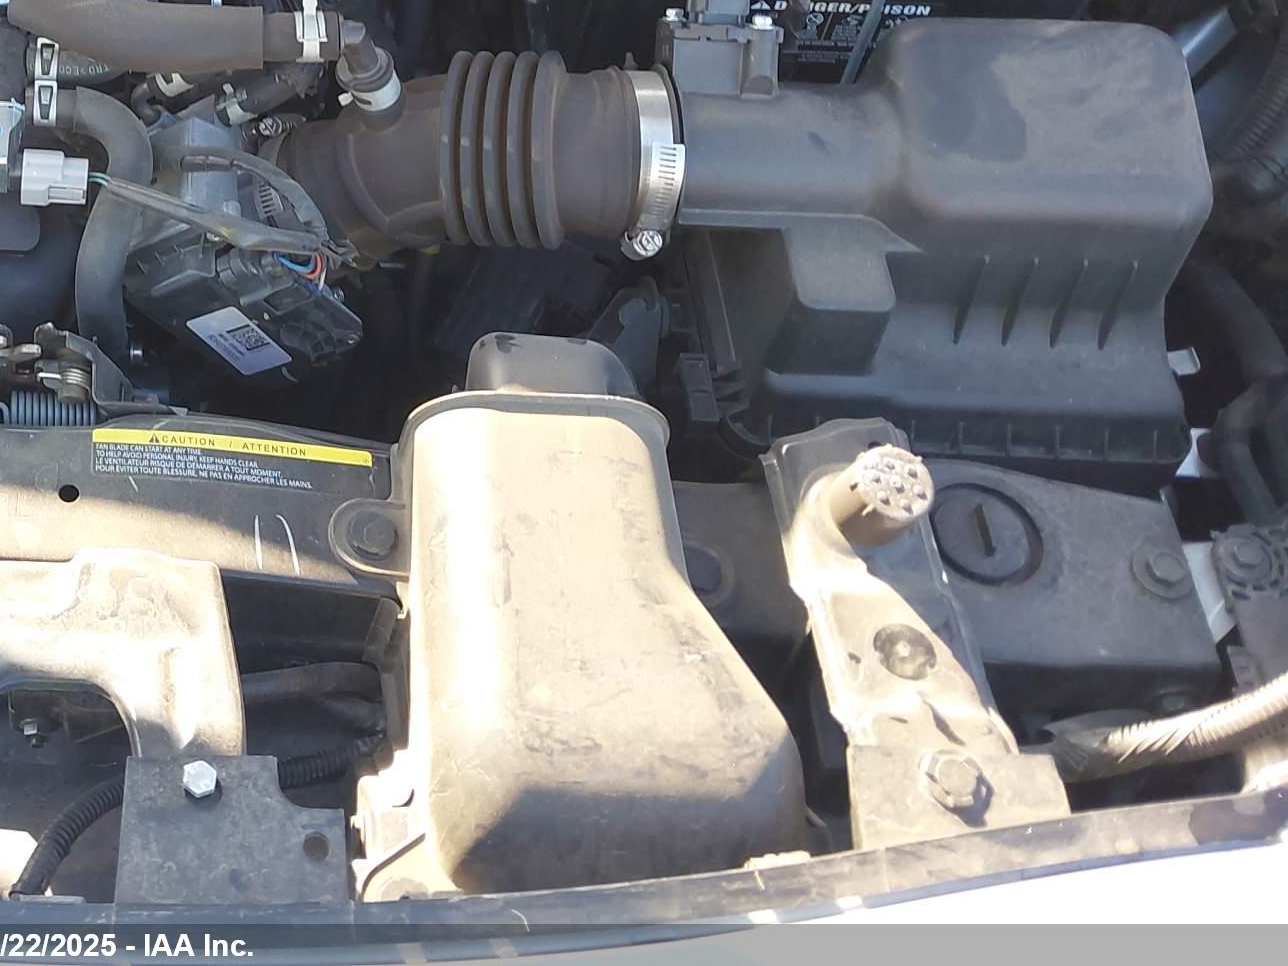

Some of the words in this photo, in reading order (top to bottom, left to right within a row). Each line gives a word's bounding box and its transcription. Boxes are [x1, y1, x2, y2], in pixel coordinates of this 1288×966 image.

[774, 0, 931, 16] DGER/PISON
[109, 443, 128, 451] BLADE
[129, 444, 144, 452] CAN
[145, 445, 163, 453] START
[162, 435, 215, 446] CAUTION
[242, 442, 307, 456] ATTENTION
[104, 457, 149, 467] VENTILATEUR
[150, 459, 175, 469] RISQUE
[175, 461, 185, 469] DE
[231, 465, 248, 474] TOUT
[106, 450, 121, 458] HELP
[122, 451, 142, 459] AVOID
[143, 452, 175, 461] PERSONAL
[199, 455, 213, 464] KEEP
[214, 457, 237, 466] HANDS
[96, 464, 114, 473] POUR
[140, 467, 162, 475] TOUTE
[209, 471, 222, 479] PAS
[223, 472, 233, 481] EN
[234, 474, 275, 485] APPROCHER
[276, 477, 288, 486] LES
